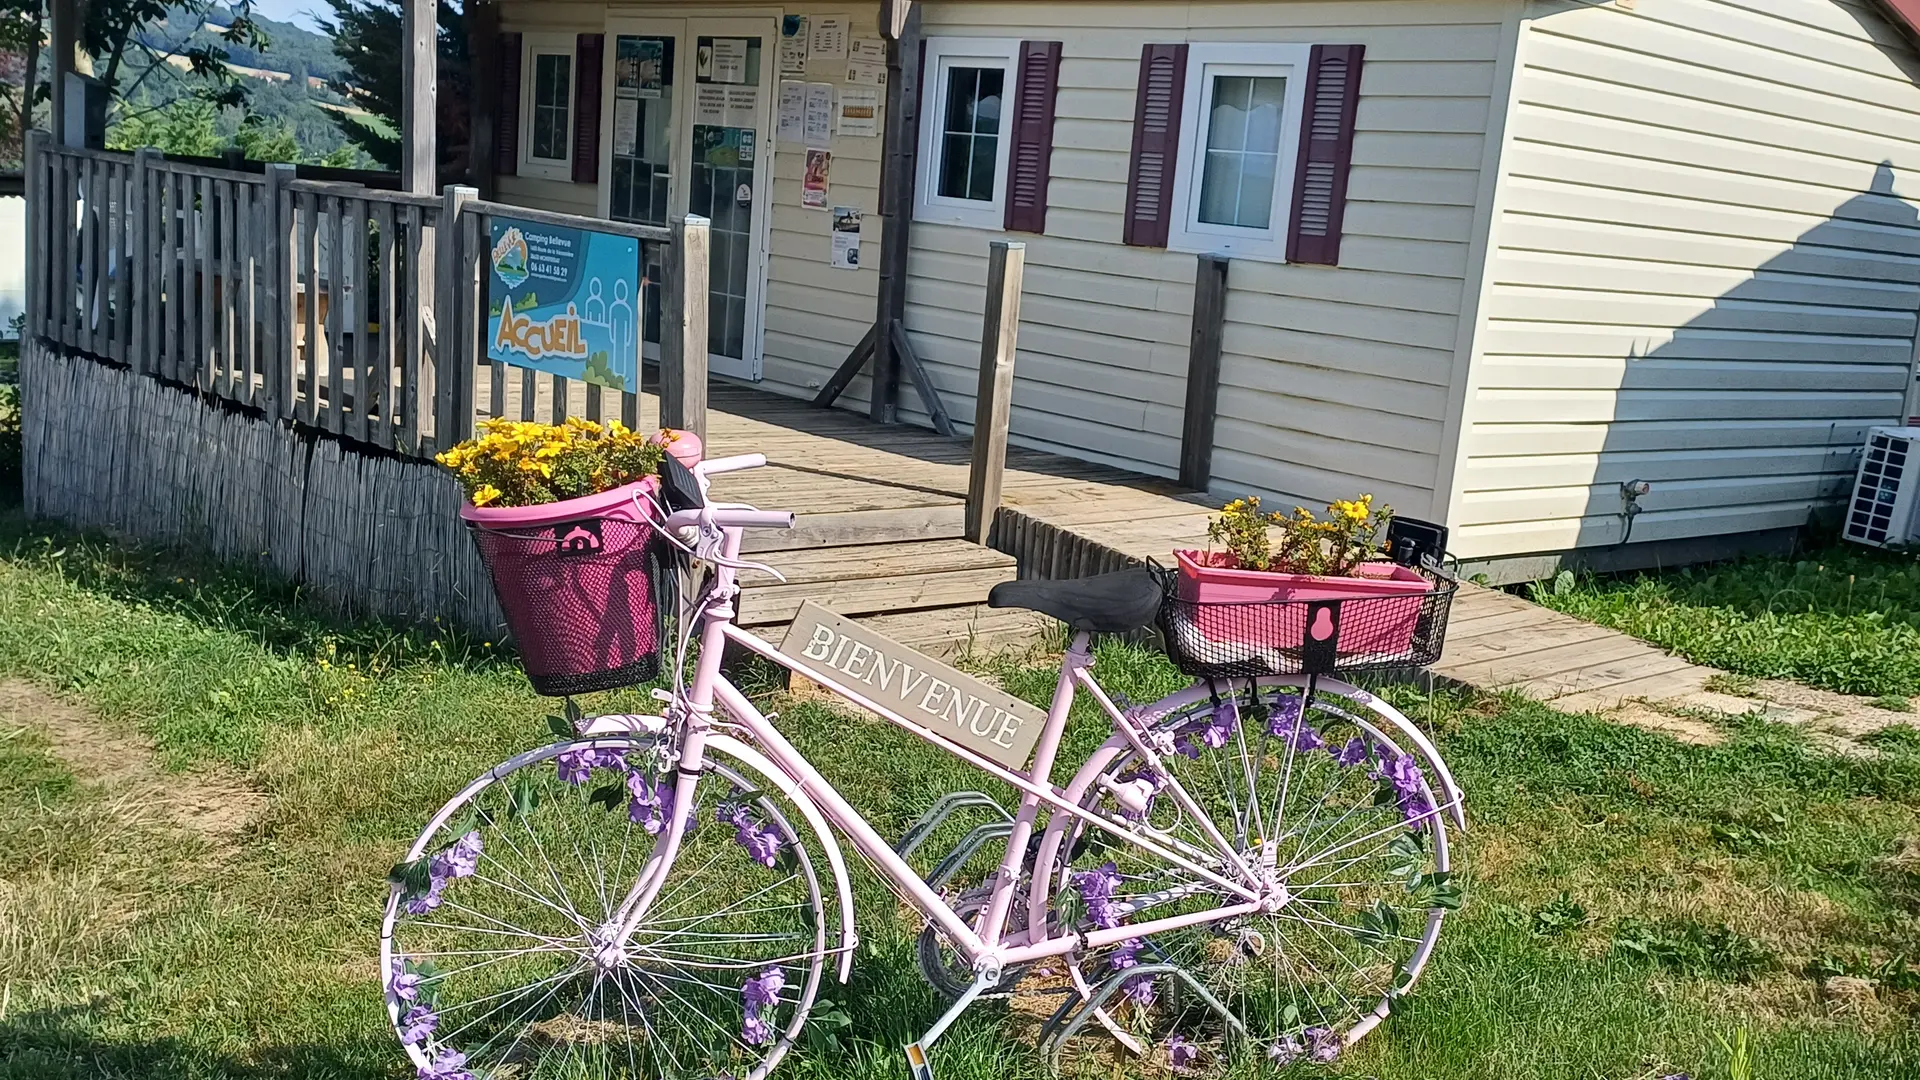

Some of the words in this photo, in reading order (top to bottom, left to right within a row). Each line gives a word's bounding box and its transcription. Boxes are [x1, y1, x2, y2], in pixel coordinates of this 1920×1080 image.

[525, 231, 548, 245] Camping
[549, 235, 571, 247] Bellevue
[530, 262, 537, 272] 06
[545, 265, 552, 274] 41
[560, 267, 568, 277] 29
[497, 303, 586, 355] ACCUEIL
[800, 622, 1024, 750] BIENVENUE
